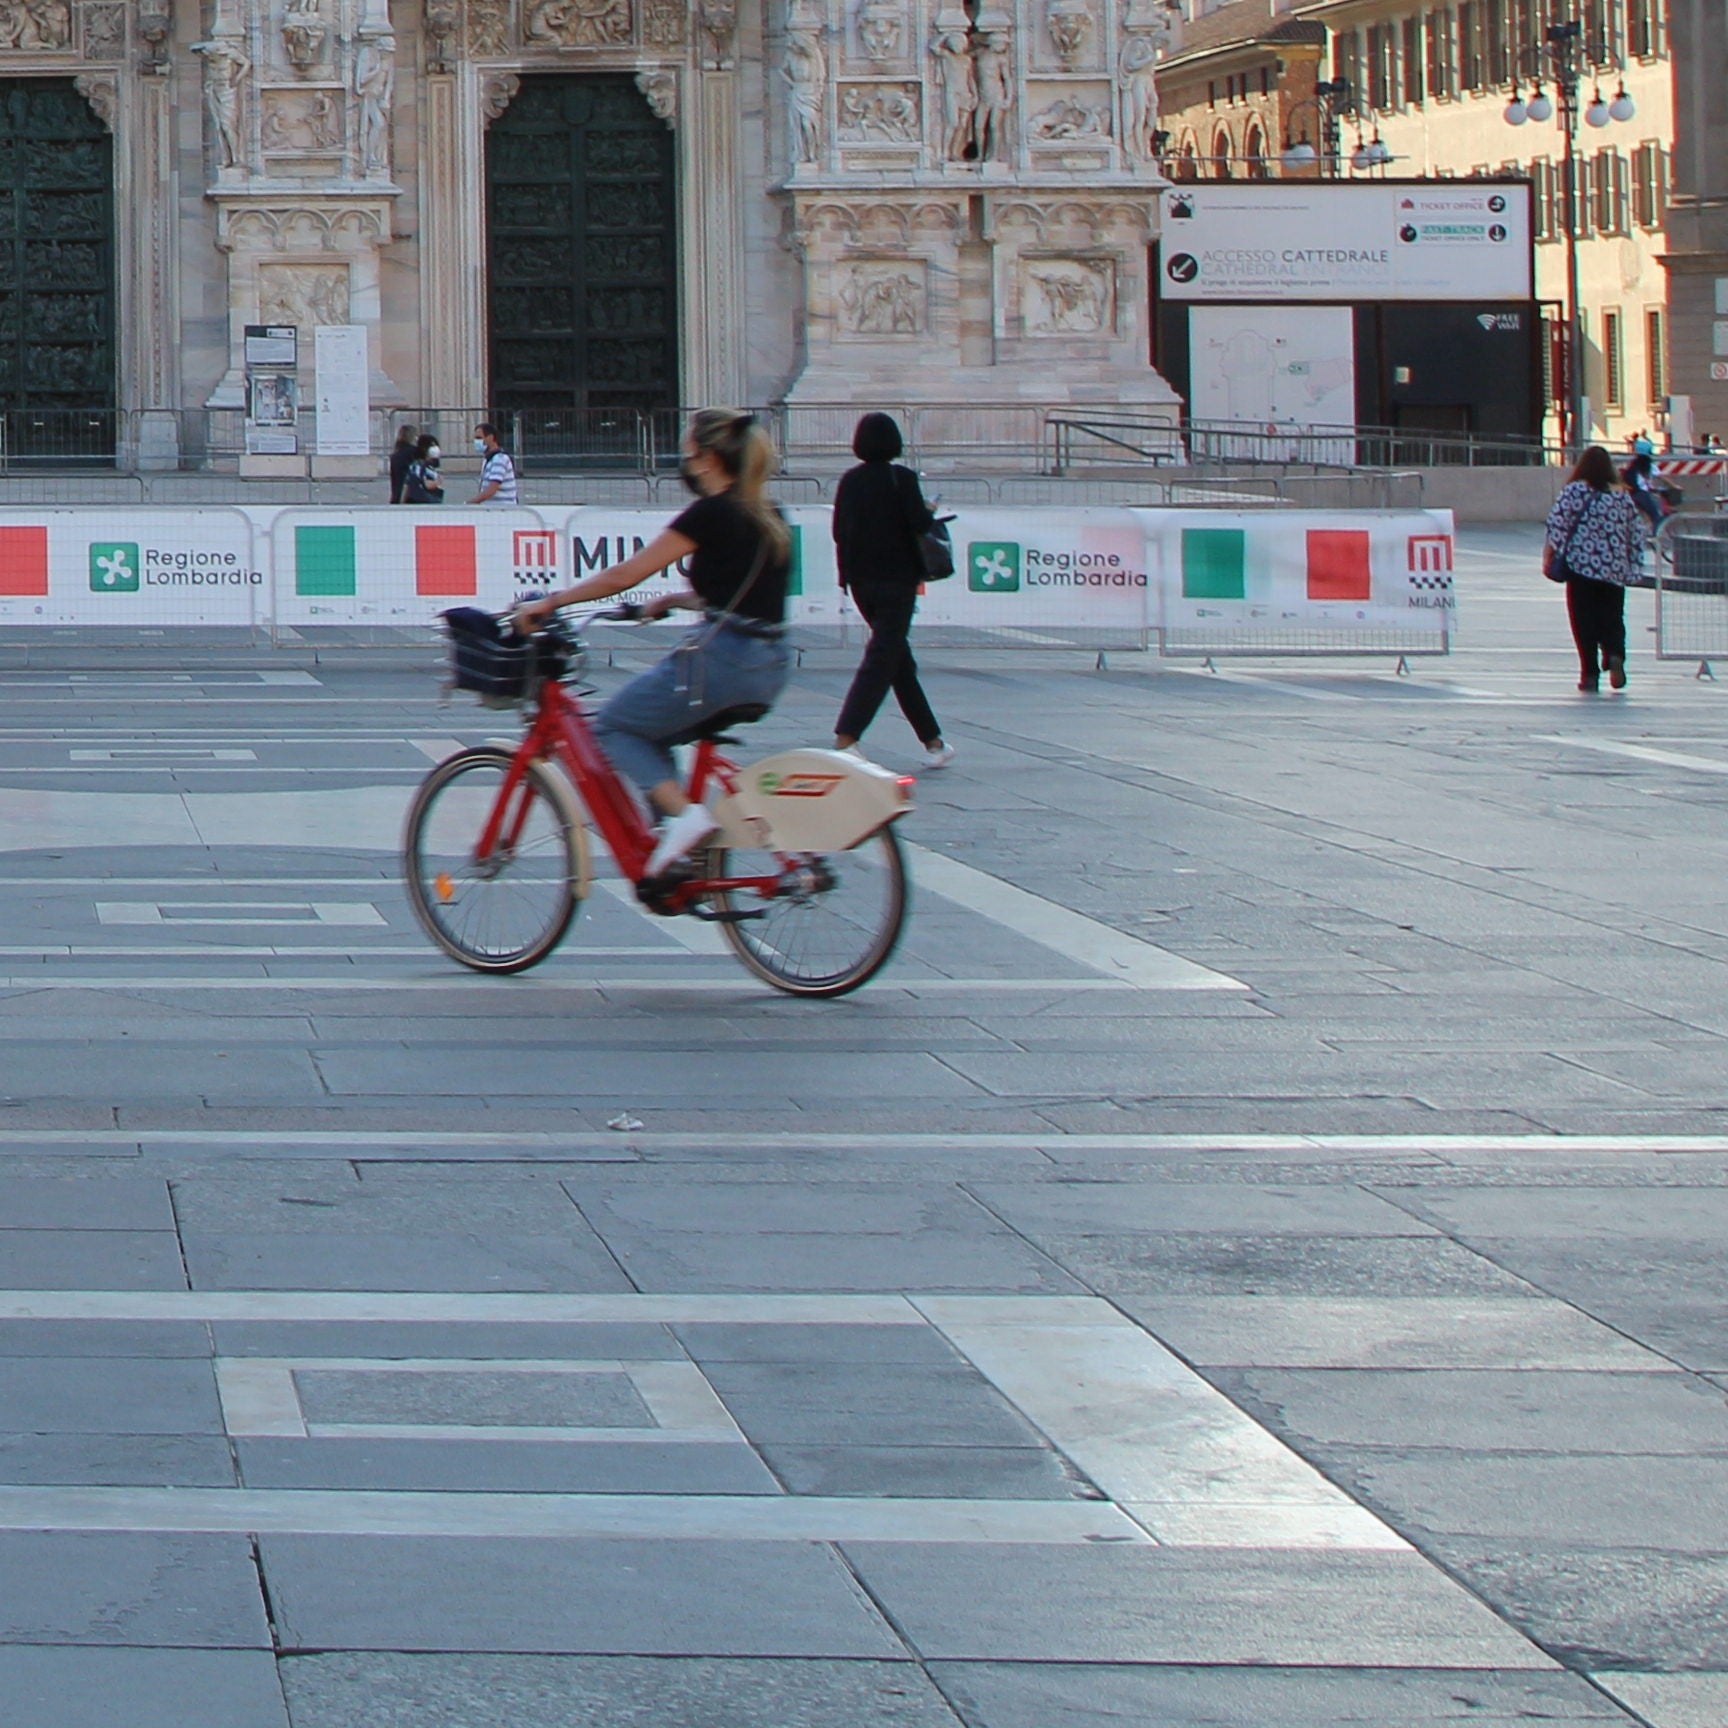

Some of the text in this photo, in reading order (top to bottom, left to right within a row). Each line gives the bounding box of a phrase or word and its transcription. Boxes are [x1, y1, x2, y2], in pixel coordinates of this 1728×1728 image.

[1202, 250, 1388, 262] ACCESSO CATTEDRALE
[1202, 263, 1297, 275] CATHEDRAL
[146, 549, 236, 568] Regione
[1027, 550, 1120, 567] Regione
[146, 570, 263, 585] Lombardia
[1027, 571, 1147, 587] Lombardia
